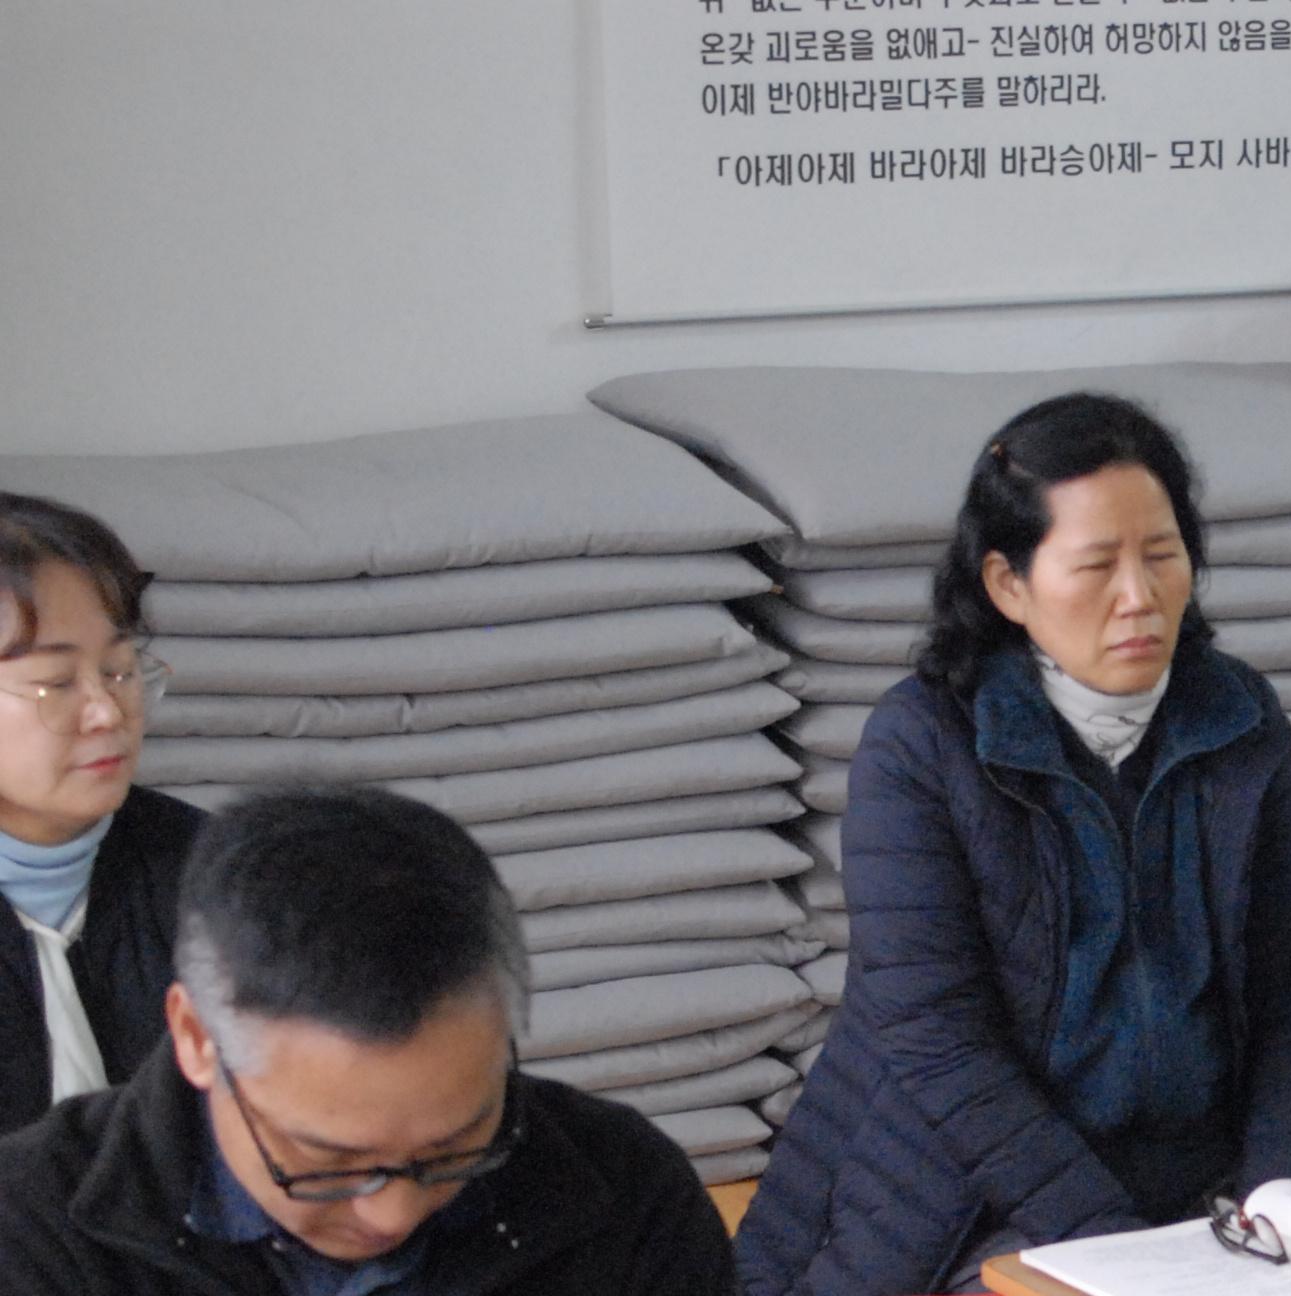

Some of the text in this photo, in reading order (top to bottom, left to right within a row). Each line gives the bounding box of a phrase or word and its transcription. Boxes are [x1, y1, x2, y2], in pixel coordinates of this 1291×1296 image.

[699, 31, 755, 66] 온갖
[765, 28, 875, 64] 괴로움을
[990, 23, 1094, 58] 진실하여
[1105, 20, 1207, 55] 허망하지
[701, 72, 1107, 117] 이제 반야바라밀다주를 말하리라.
[869, 146, 987, 183] 바라아제
[1169, 138, 1224, 171] 모지
